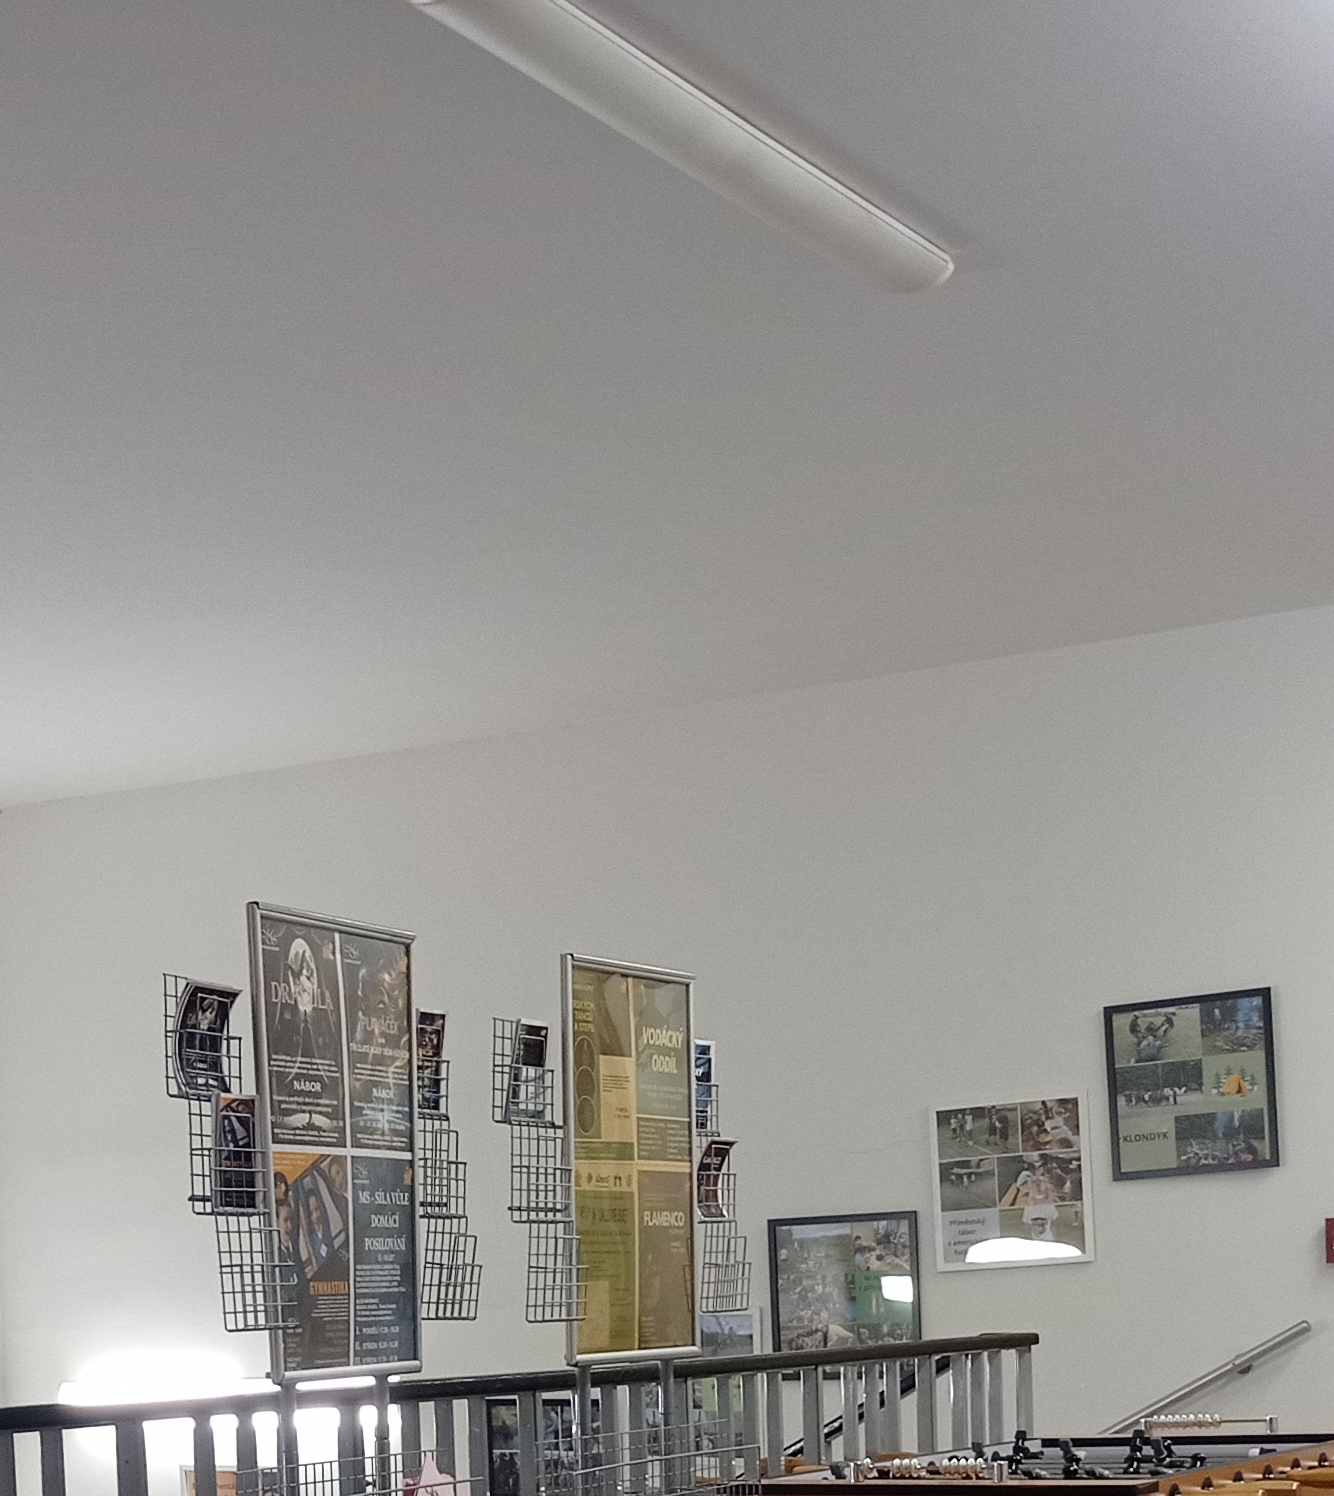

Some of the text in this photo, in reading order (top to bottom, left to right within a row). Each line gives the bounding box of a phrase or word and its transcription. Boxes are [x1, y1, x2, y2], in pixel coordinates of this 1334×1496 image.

[642, 1025, 684, 1049] VODÁCKÝ
[652, 1052, 678, 1074] ODDÍL
[293, 1078, 322, 1093] NÁBOR
[1122, 1131, 1168, 1143] KLONDYK
[358, 1190, 370, 1204] MS
[370, 1211, 399, 1228] DOMÁCÍ
[643, 1211, 684, 1227] FLAMENCO
[364, 1234, 406, 1251] POSILOVÁNÍ
